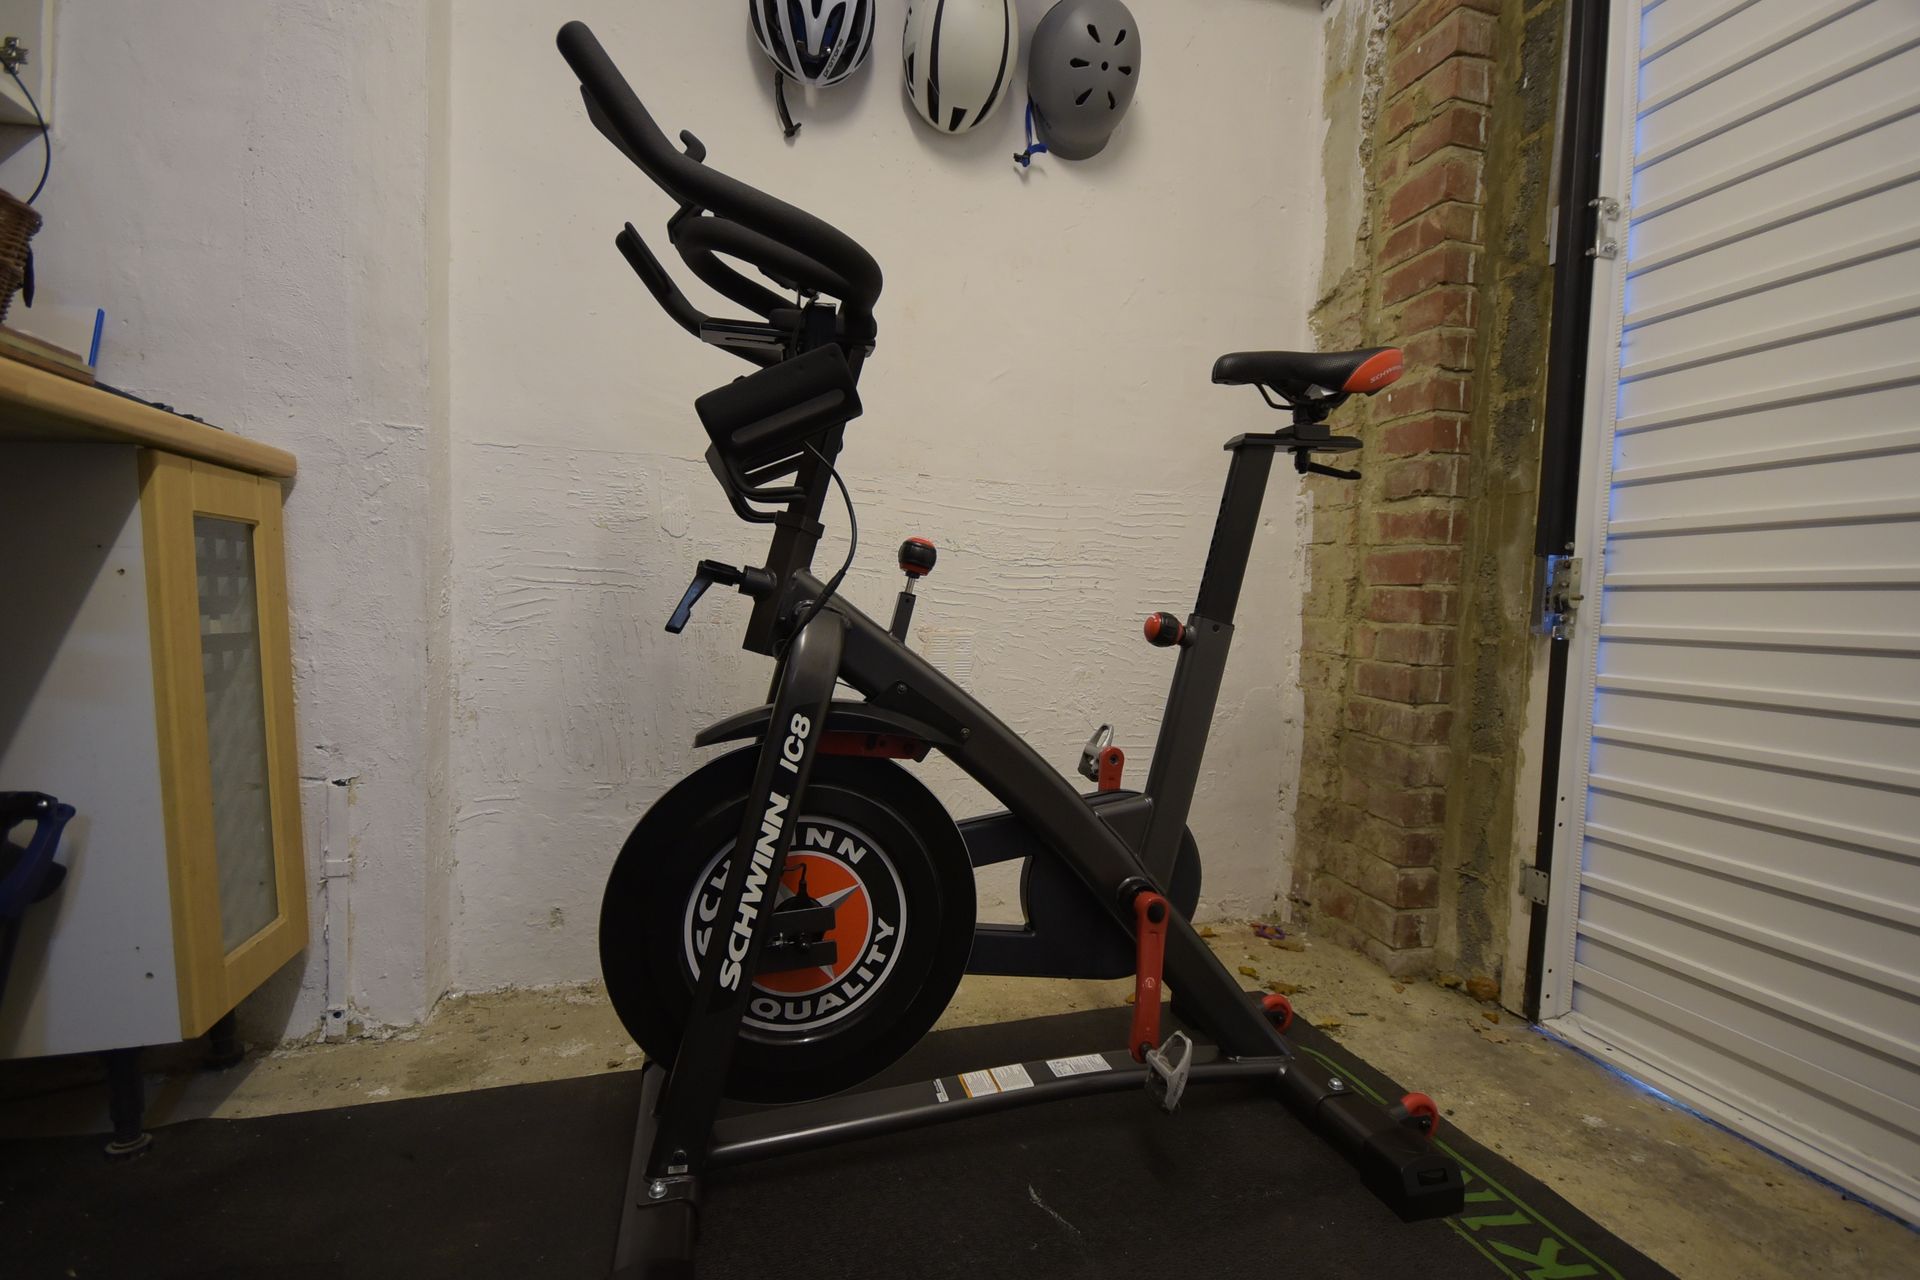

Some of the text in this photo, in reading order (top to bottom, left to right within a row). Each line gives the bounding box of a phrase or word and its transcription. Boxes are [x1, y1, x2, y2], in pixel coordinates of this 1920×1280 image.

[779, 713, 810, 773] IC8
[696, 827, 867, 956] SCHNN
[719, 791, 790, 991] SCHWINN
[750, 917, 895, 1020] QUALITY
